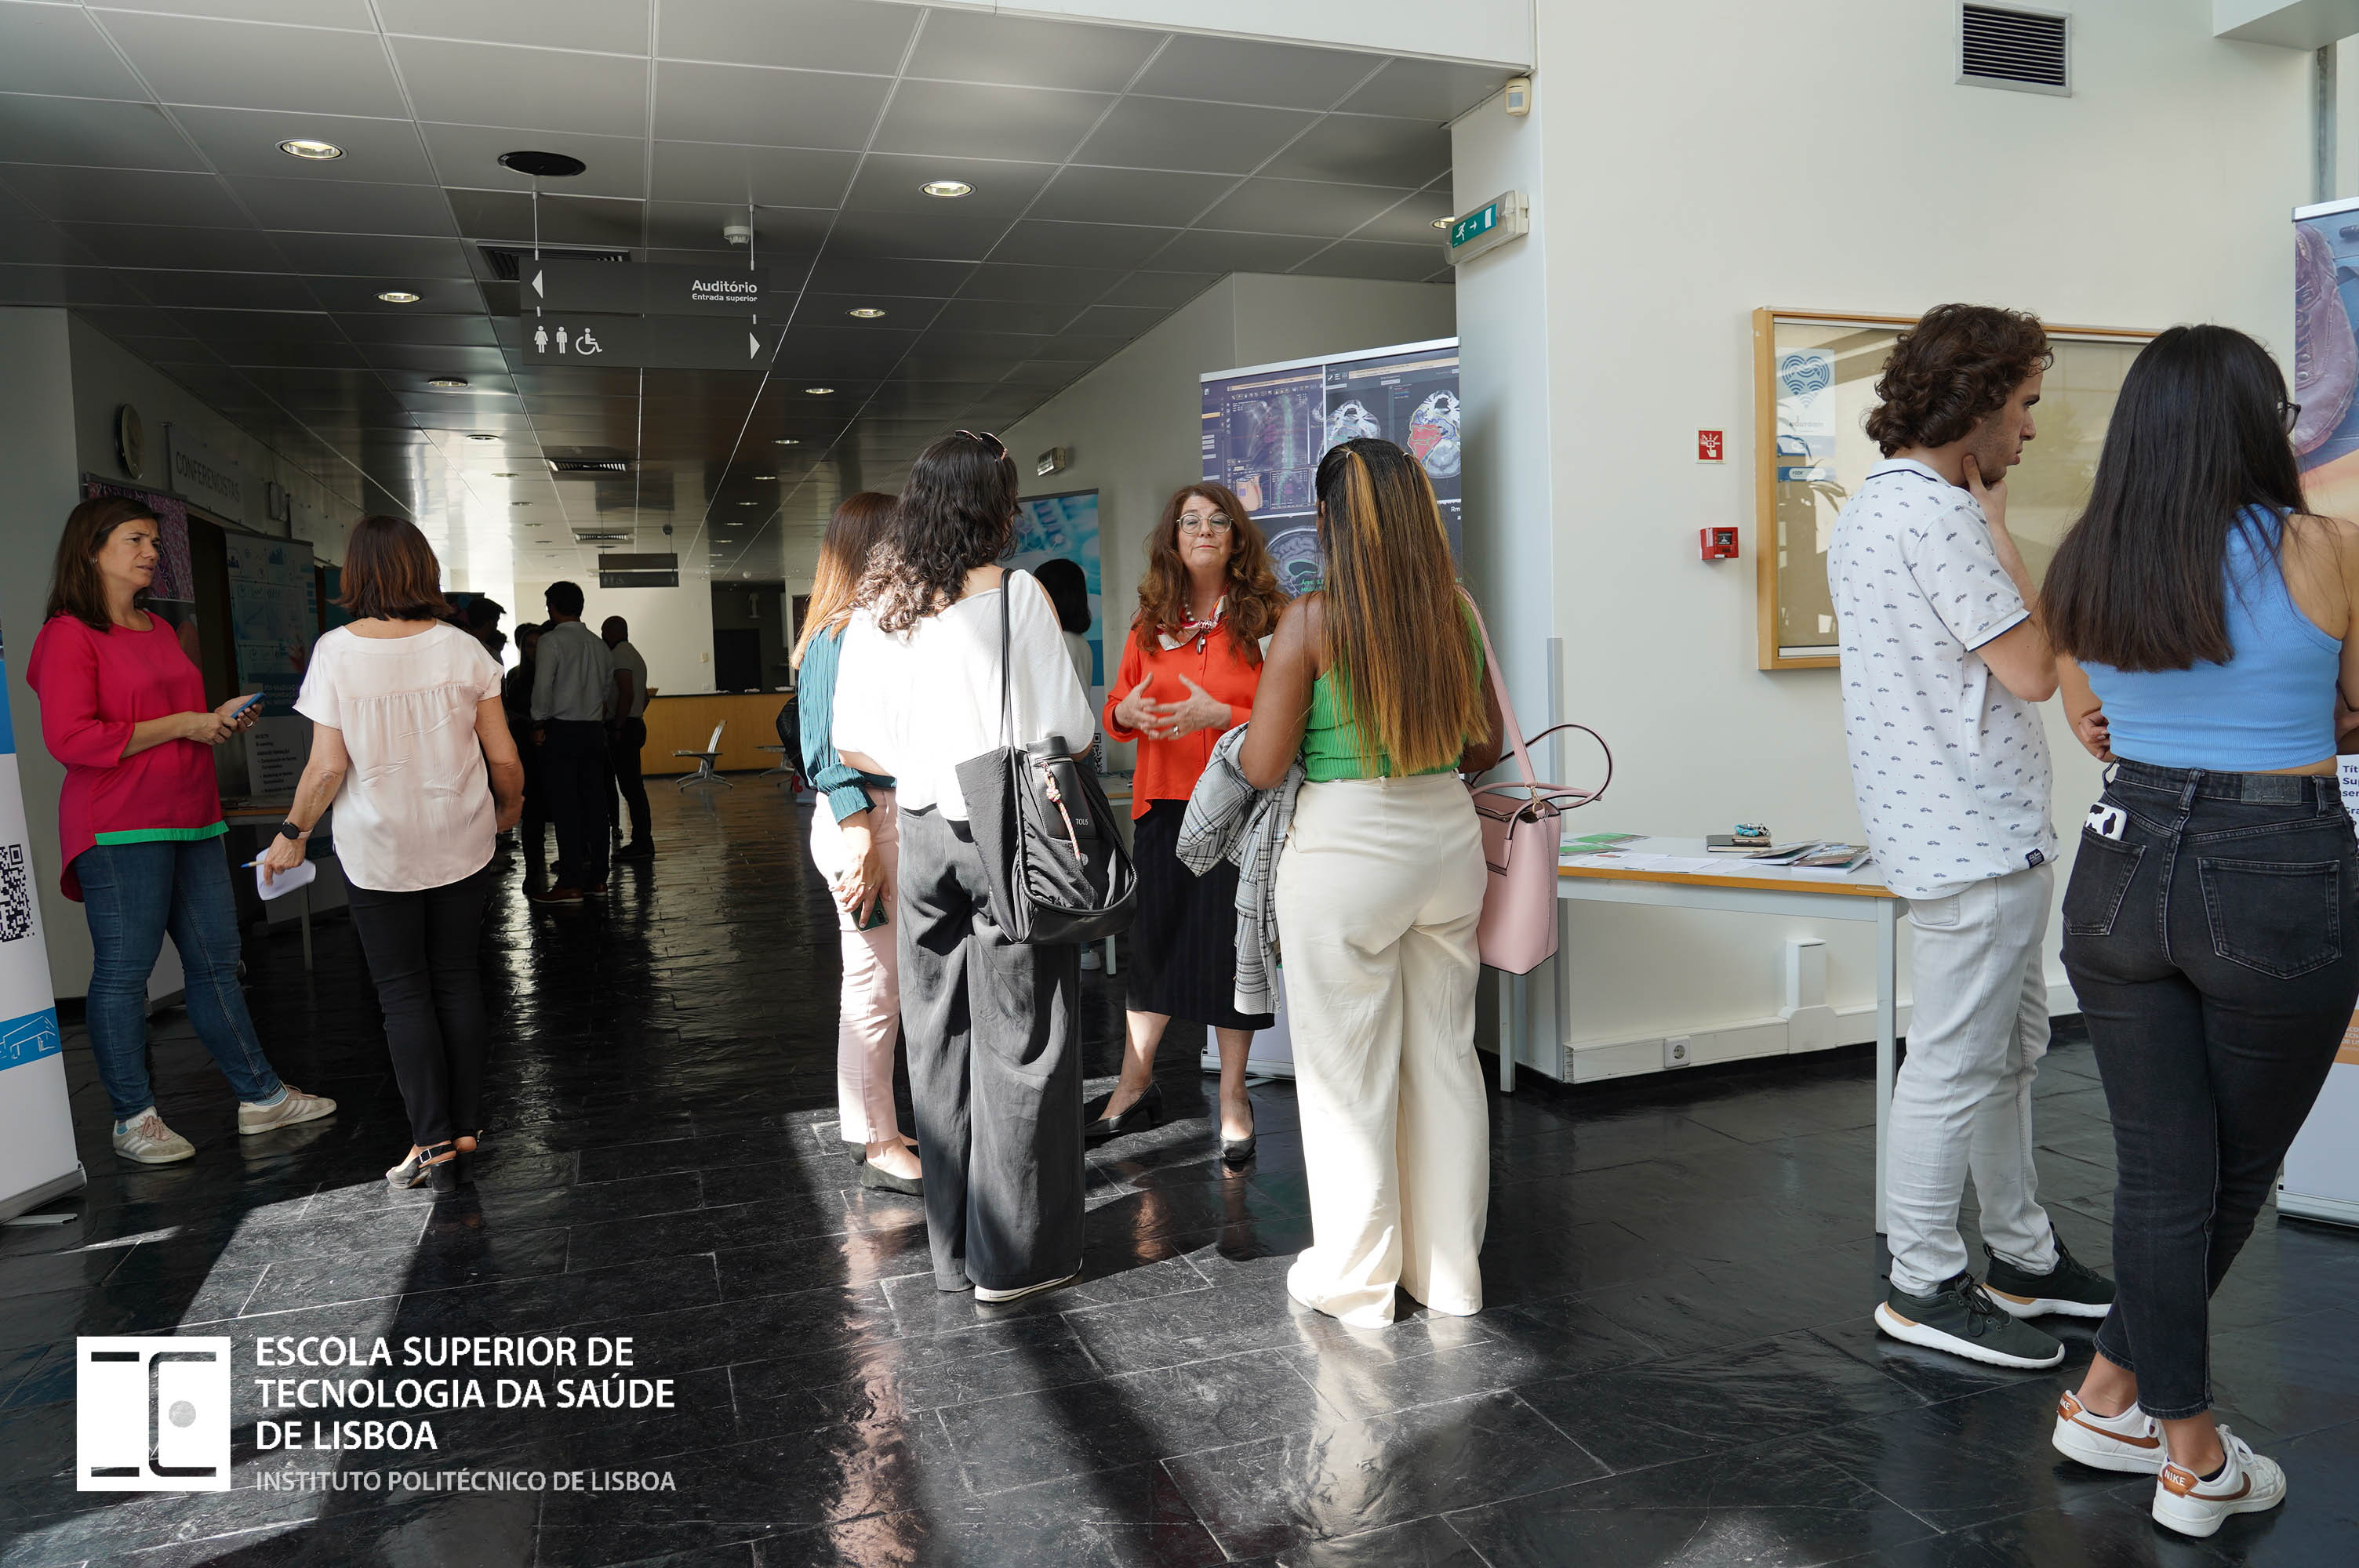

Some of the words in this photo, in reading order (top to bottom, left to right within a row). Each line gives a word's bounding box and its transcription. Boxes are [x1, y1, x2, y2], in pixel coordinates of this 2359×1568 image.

[692, 279, 758, 293] Auditório
[176, 451, 240, 503] CONFERENCISTAS
[2165, 1469, 2186, 1486] NIKE
